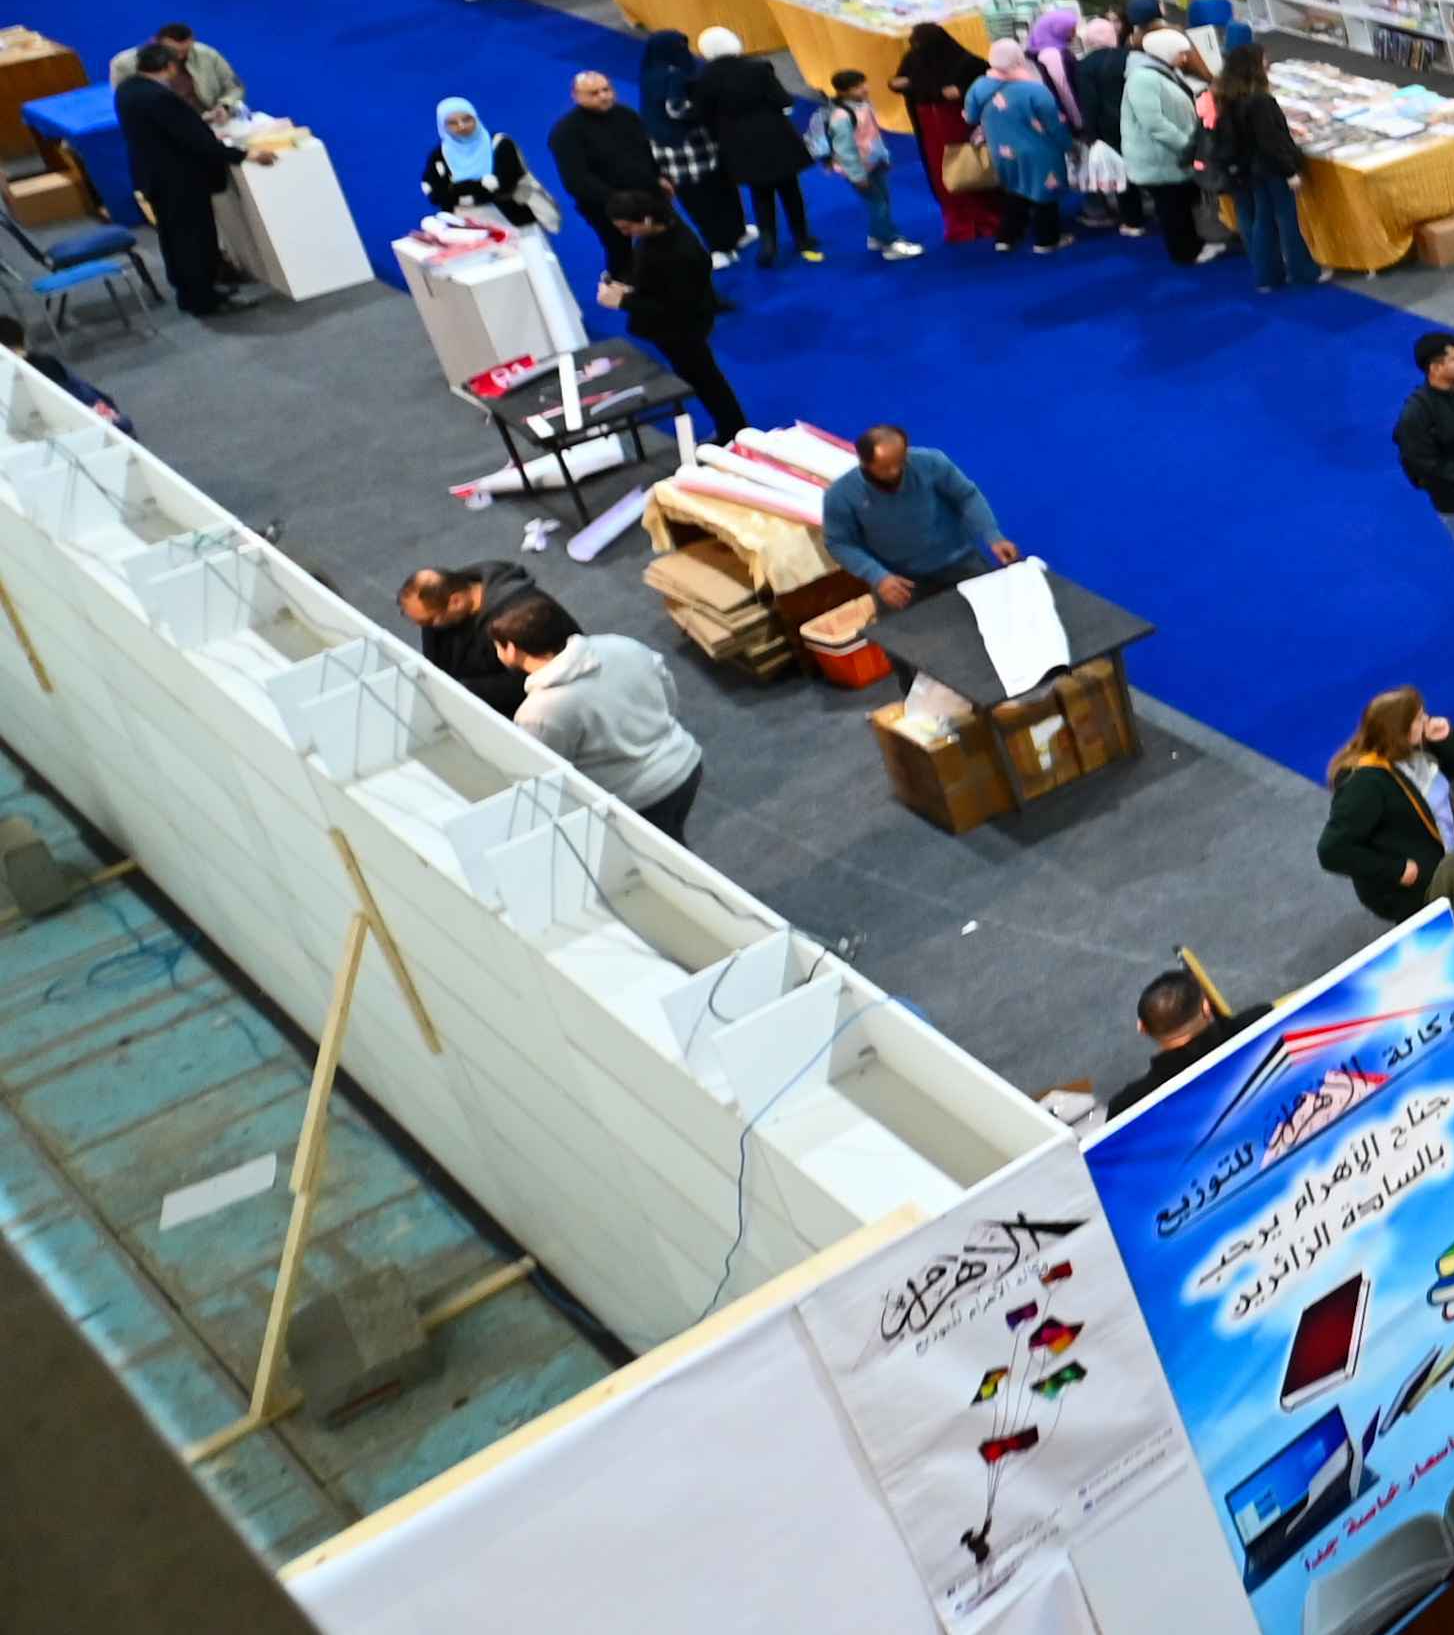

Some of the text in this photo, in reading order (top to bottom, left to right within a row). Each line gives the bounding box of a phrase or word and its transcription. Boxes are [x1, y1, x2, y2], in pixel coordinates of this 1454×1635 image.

[1156, 1142, 1254, 1239] للتوزيع
[1197, 1095, 1450, 1289] جناح الأهرام يرحب
[1233, 1142, 1445, 1320] بالسادة الزائرين
